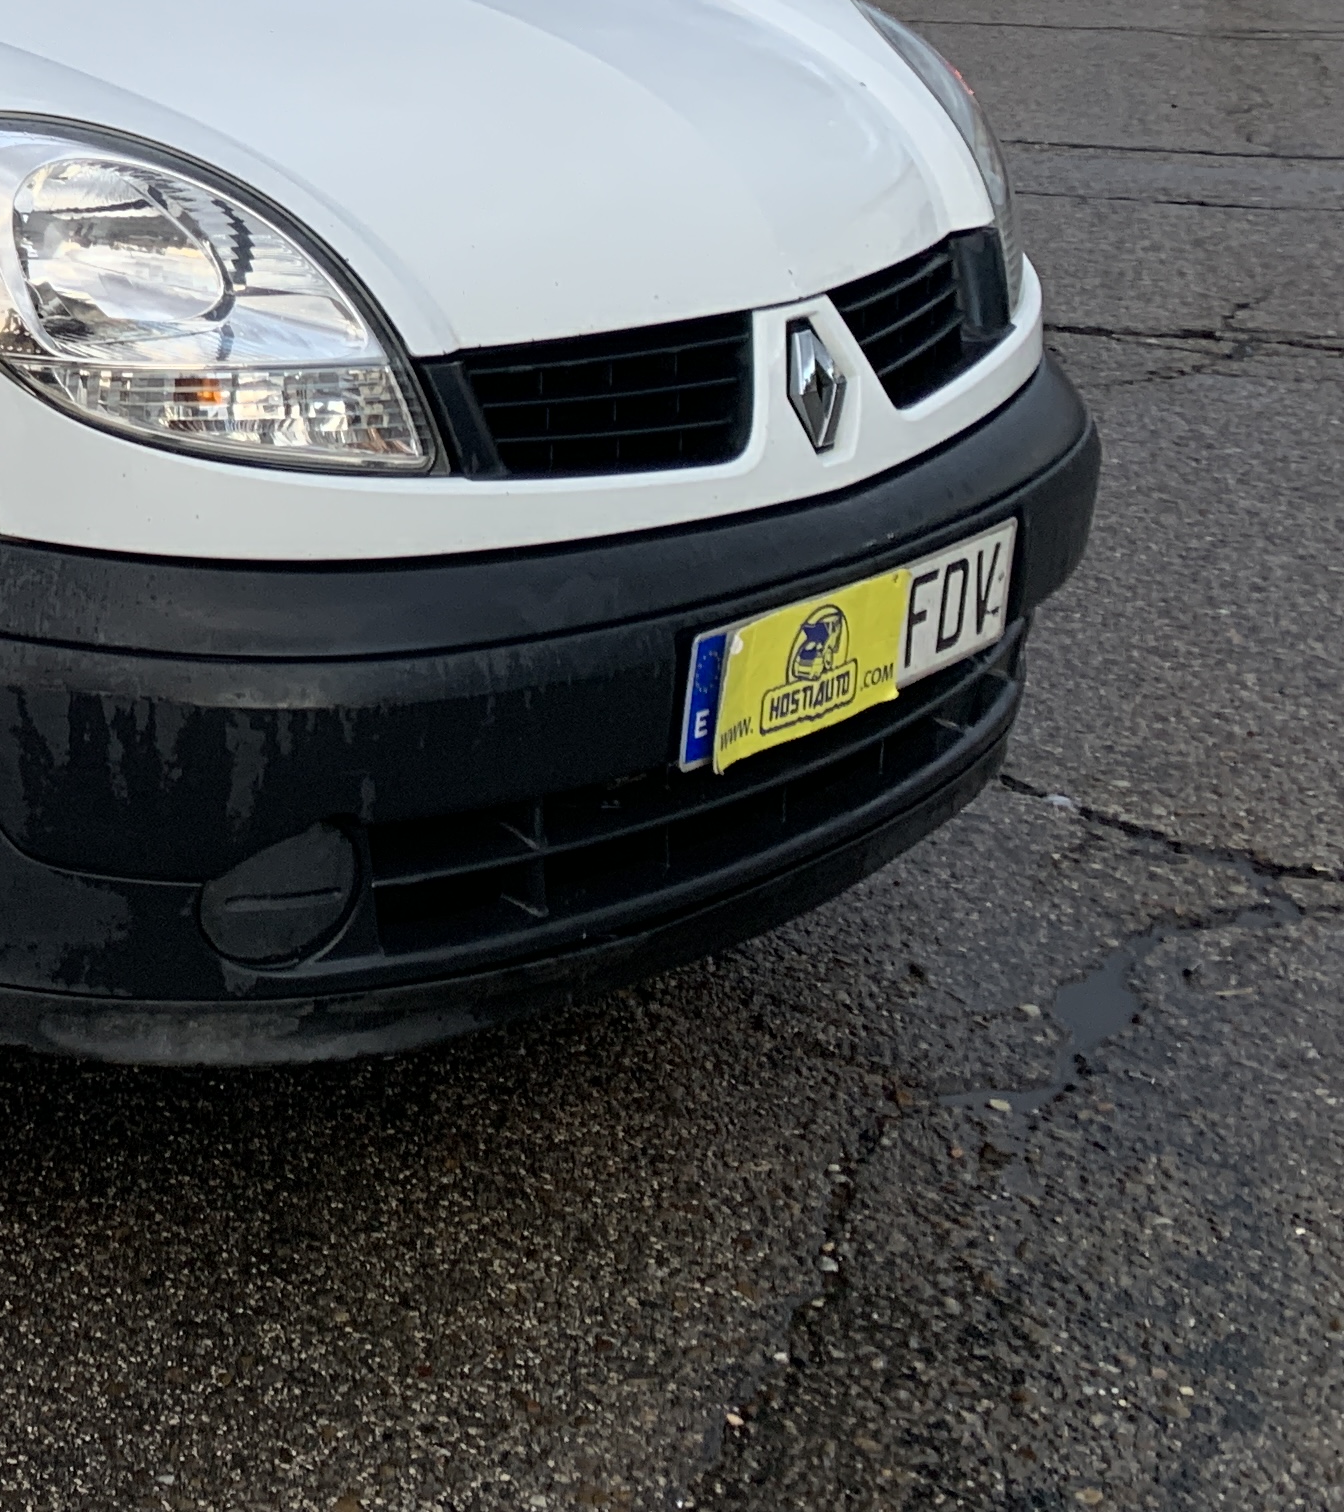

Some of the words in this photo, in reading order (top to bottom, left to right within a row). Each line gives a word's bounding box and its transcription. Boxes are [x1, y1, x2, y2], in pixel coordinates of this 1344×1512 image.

[904, 541, 1002, 669] FDV
[768, 672, 851, 721] HOSTIAUTO
[693, 708, 709, 738] E
